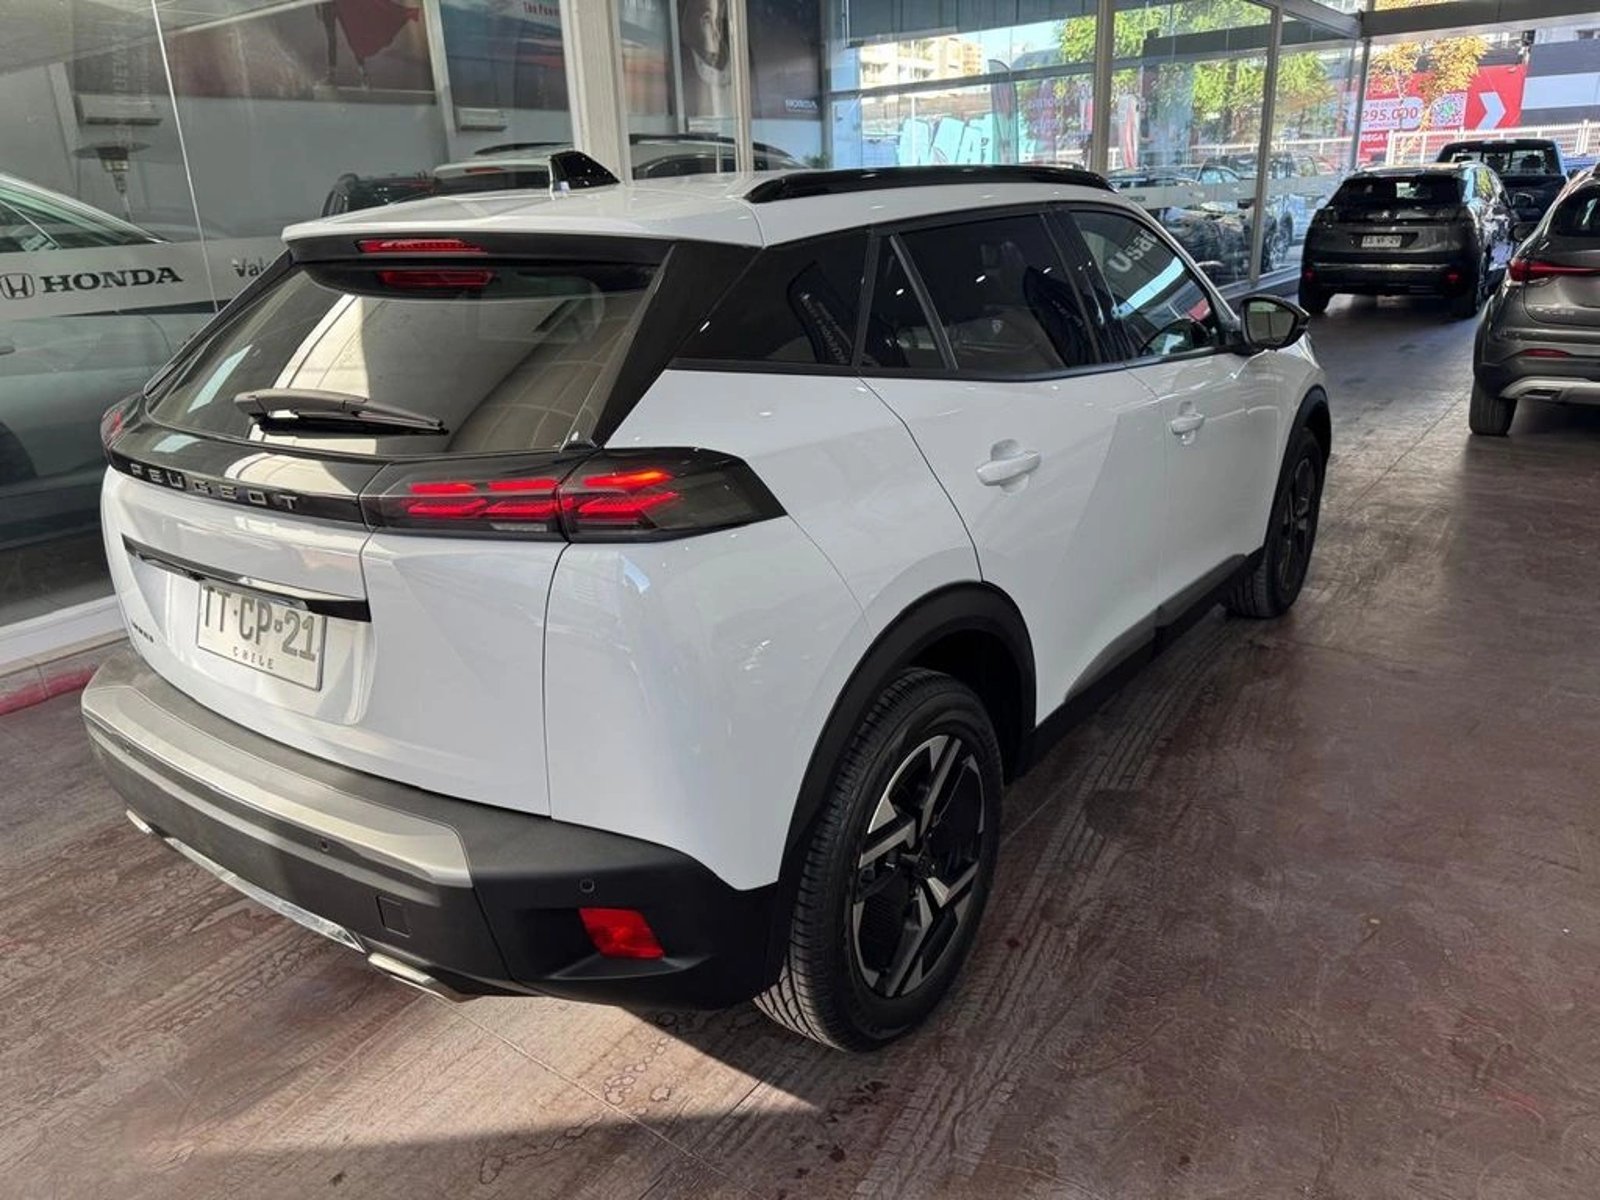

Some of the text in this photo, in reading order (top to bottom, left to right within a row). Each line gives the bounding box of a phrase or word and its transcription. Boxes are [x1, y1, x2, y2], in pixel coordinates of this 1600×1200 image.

[40, 267, 183, 293] HONDA
[130, 463, 300, 510] PEUGEOT
[232, 646, 274, 670] CHILE
